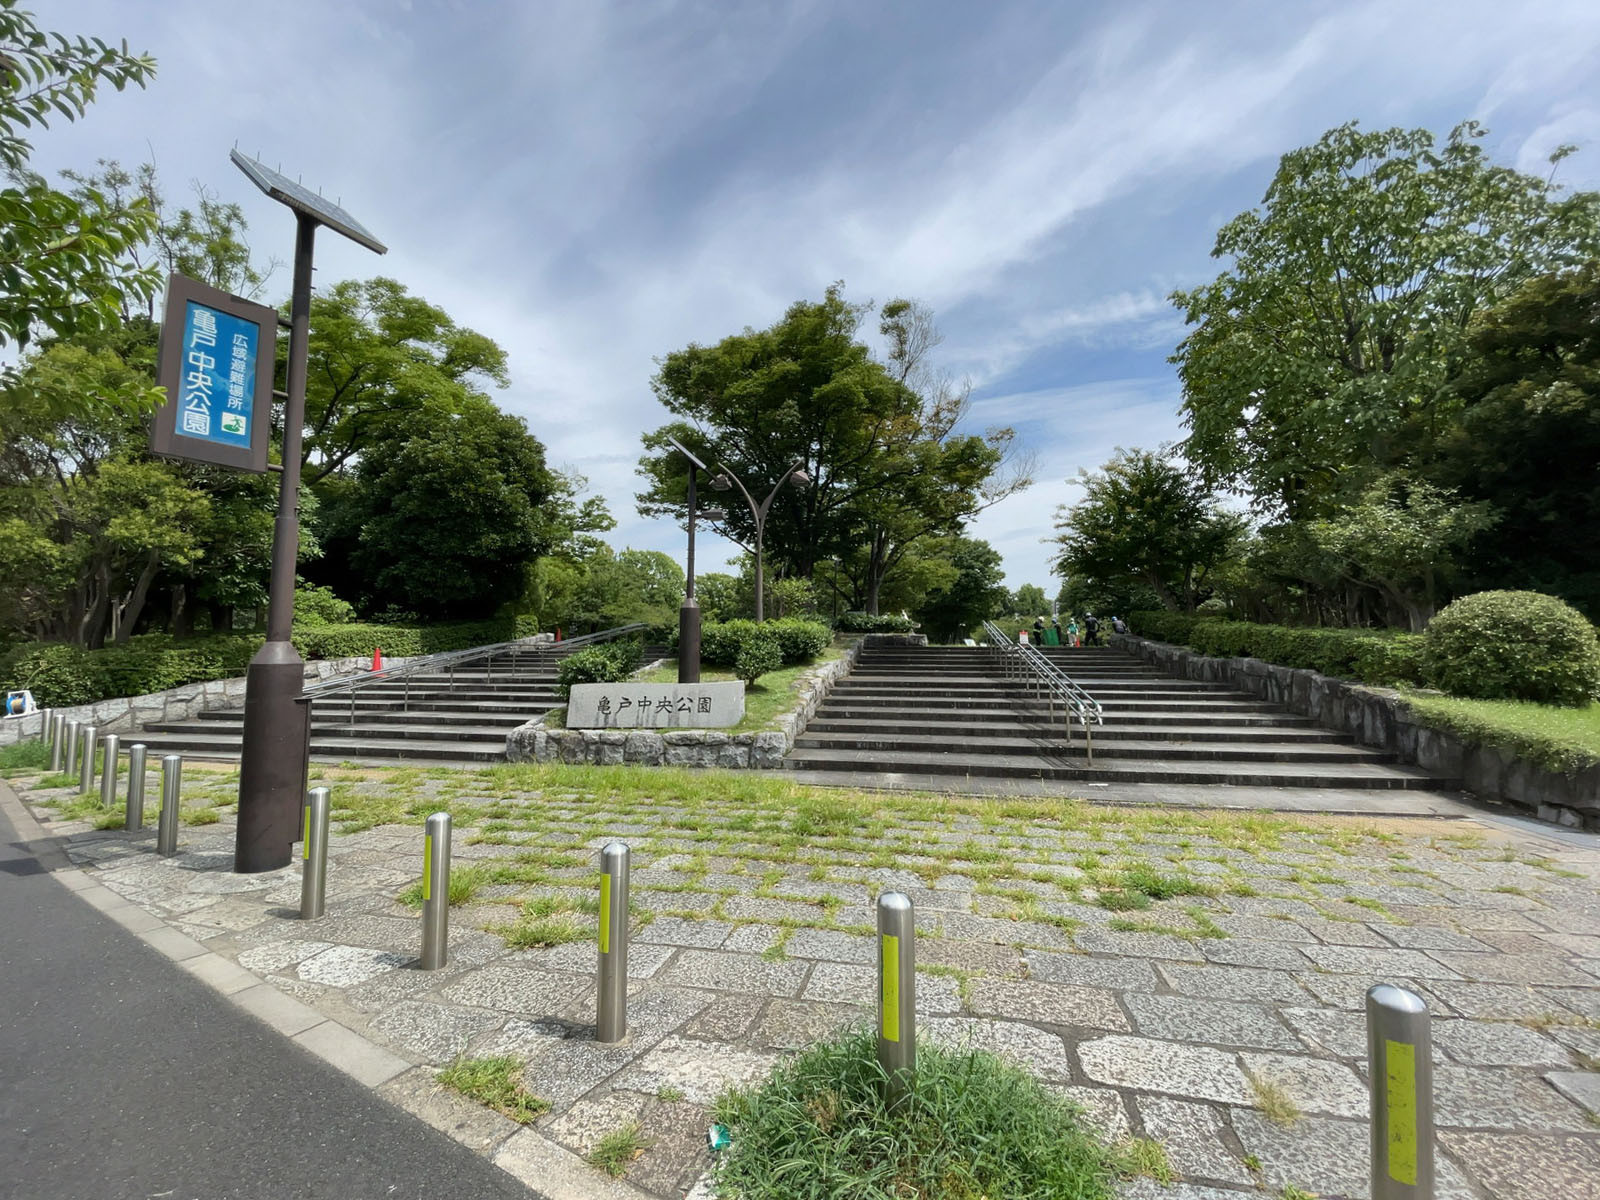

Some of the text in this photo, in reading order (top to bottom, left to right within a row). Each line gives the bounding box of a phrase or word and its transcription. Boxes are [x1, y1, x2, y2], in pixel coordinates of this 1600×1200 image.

[183, 309, 217, 435] 亀戸中央公園
[227, 334, 249, 410] 広域避難場所
[597, 695, 712, 715] 亀戸中央公園
